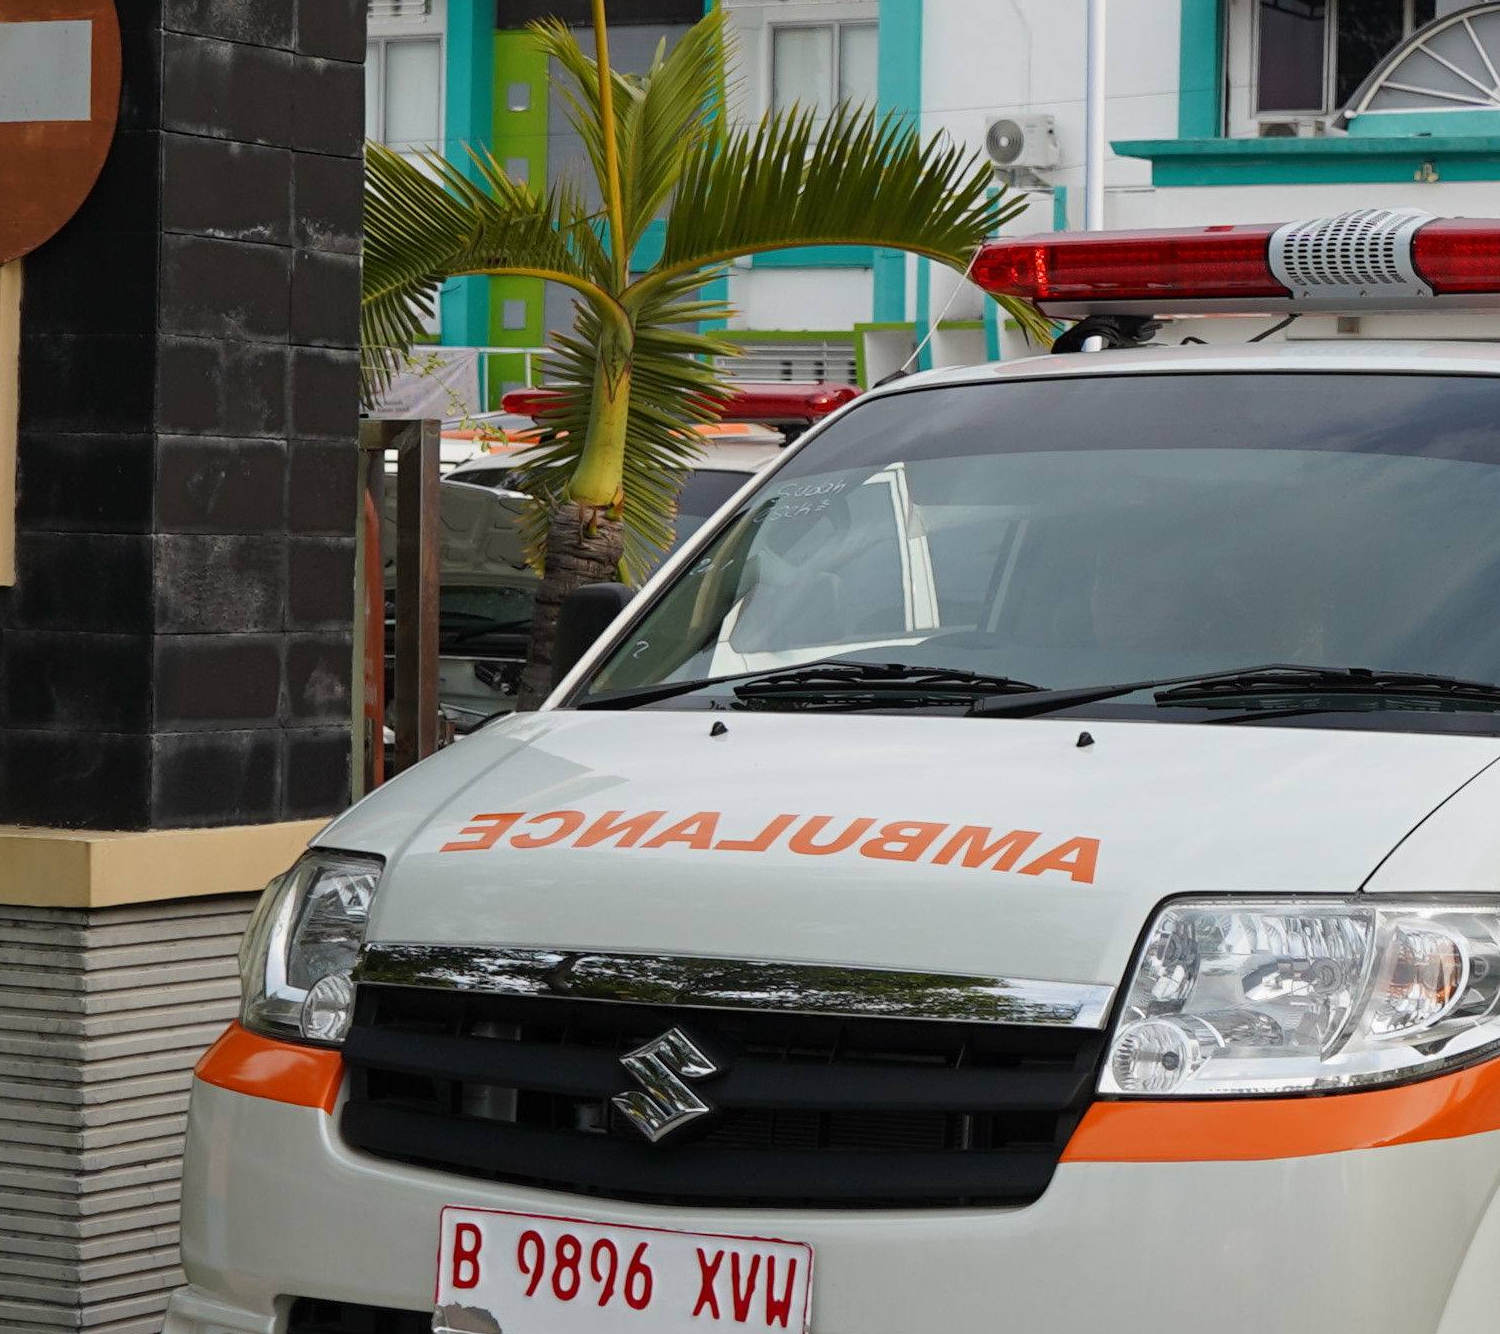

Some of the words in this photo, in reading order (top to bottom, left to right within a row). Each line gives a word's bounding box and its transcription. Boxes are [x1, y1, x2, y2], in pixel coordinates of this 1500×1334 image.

[452, 1222, 483, 1289] B
[517, 1229, 653, 1310] 9896
[691, 1246, 798, 1328] XVW
